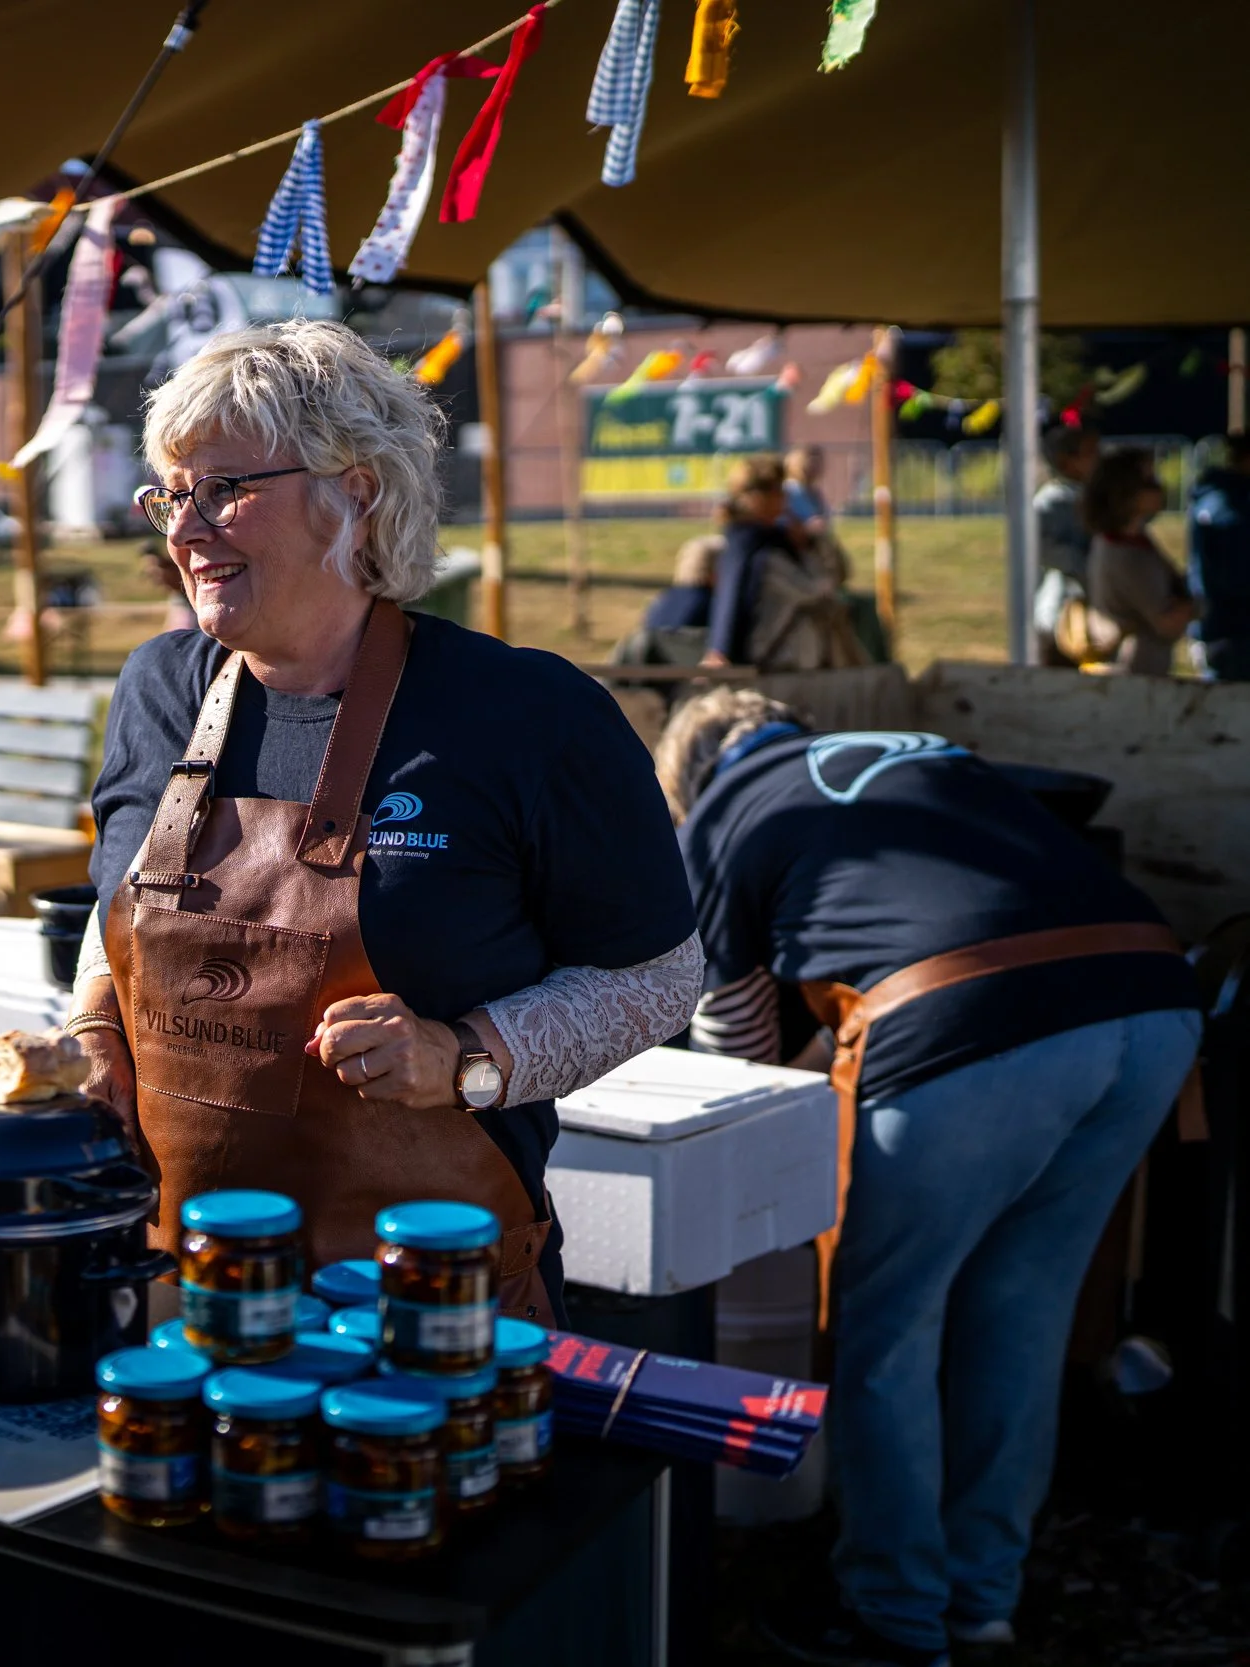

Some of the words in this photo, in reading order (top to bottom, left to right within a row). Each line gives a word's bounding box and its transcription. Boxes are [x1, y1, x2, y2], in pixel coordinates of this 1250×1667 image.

[406, 832, 449, 849] BLUE
[386, 849, 403, 857] mere
[403, 850, 430, 860] mening
[146, 1010, 228, 1043] VILSUND
[231, 1025, 286, 1054] BLUE
